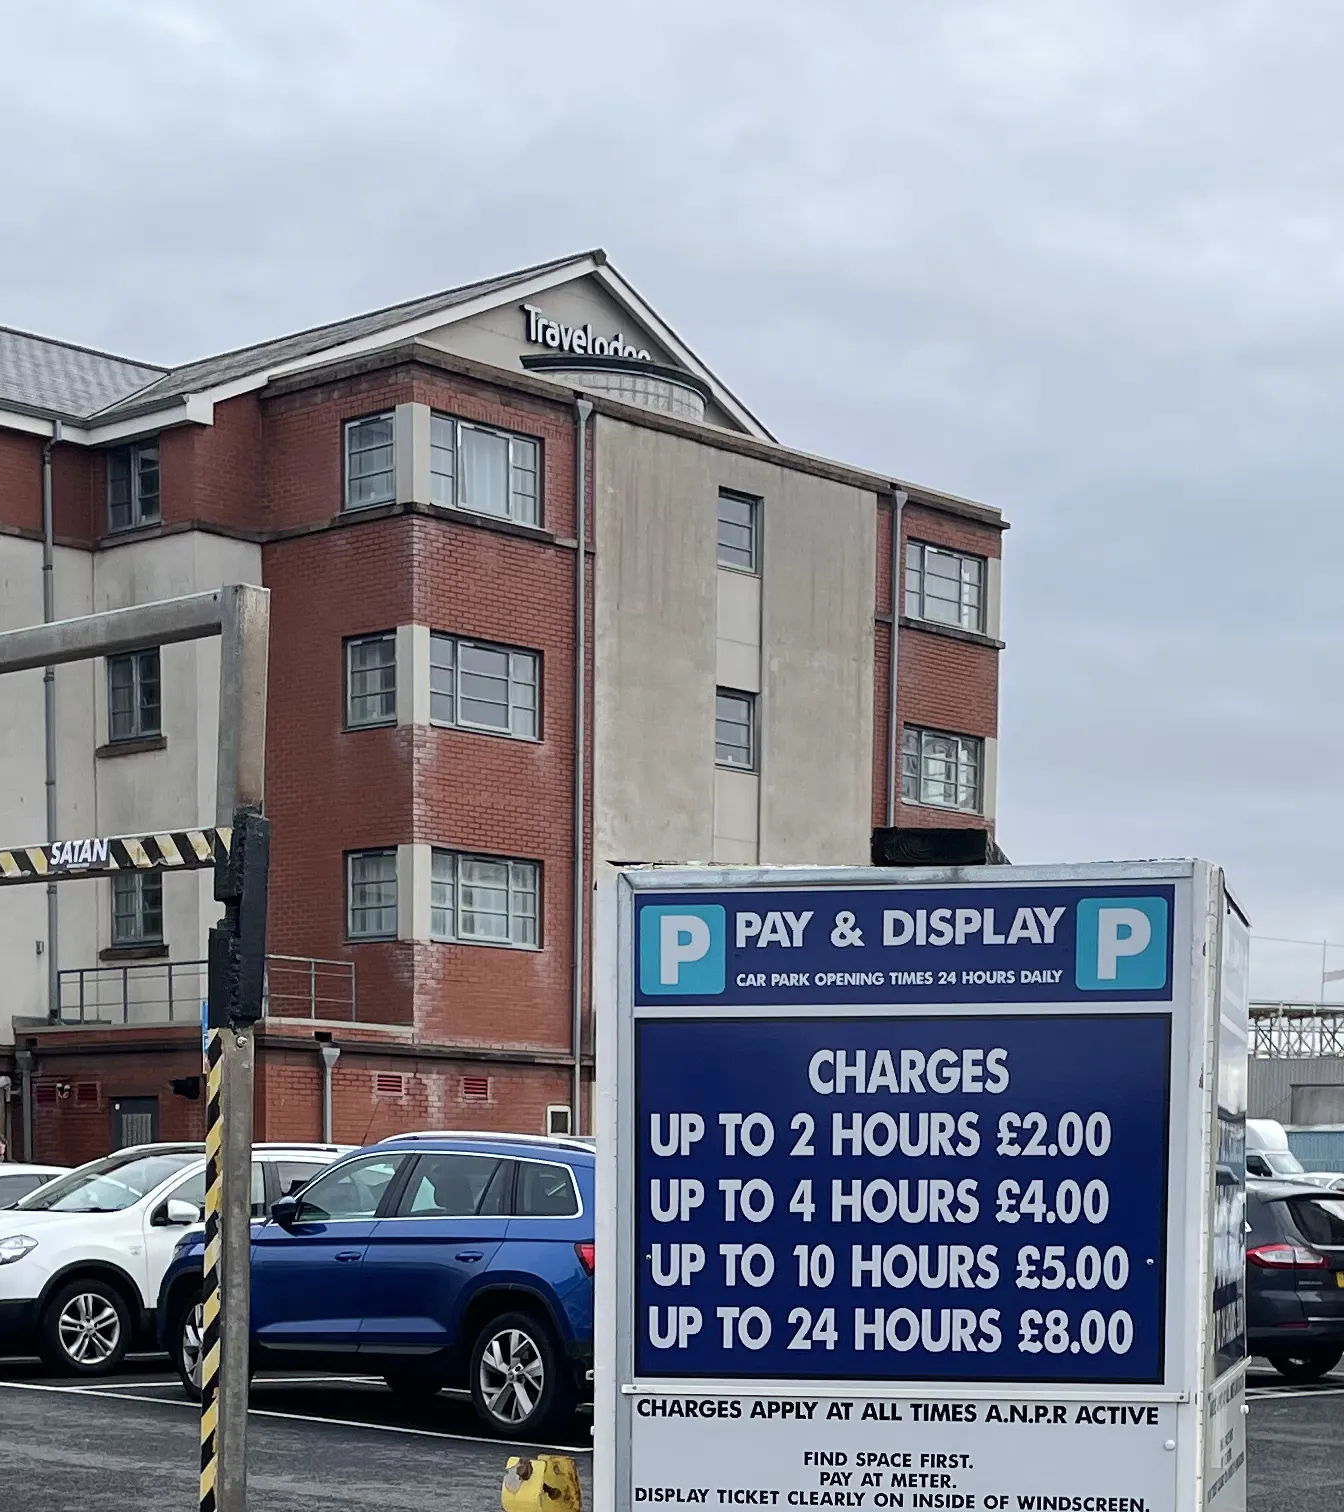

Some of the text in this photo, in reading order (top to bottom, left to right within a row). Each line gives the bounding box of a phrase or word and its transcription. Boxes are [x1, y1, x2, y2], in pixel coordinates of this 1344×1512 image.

[50, 838, 108, 865] SATAN
[736, 906, 1066, 948] PAY & DISPLAY
[1097, 907, 1152, 980] P
[660, 915, 710, 985] P
[736, 969, 1063, 987] CAR PARK OPENING TIMES 24 HOURS DAILY
[809, 1048, 1010, 1094] CHARGES
[650, 1112, 1111, 1157] UP TO 2 HOURS £2.00
[650, 1179, 1109, 1224] UP TO 4 HOURS £4.00
[650, 1245, 1129, 1291] UP TO 10 HOURS £5.00
[648, 1307, 1134, 1355] UP TO 24 HOURS £8.00
[636, 1399, 1159, 1425] CHARGES APPLY AT ALL TIMES A.N.P.R ACTIVE
[803, 1451, 973, 1469] FIND SPACE FIRST.
[820, 1472, 957, 1489] PAY AT METER.
[635, 1487, 1150, 1512] DISPLAY TICKET CLEARLY ON INSIDE OF WINDSCREEN.
